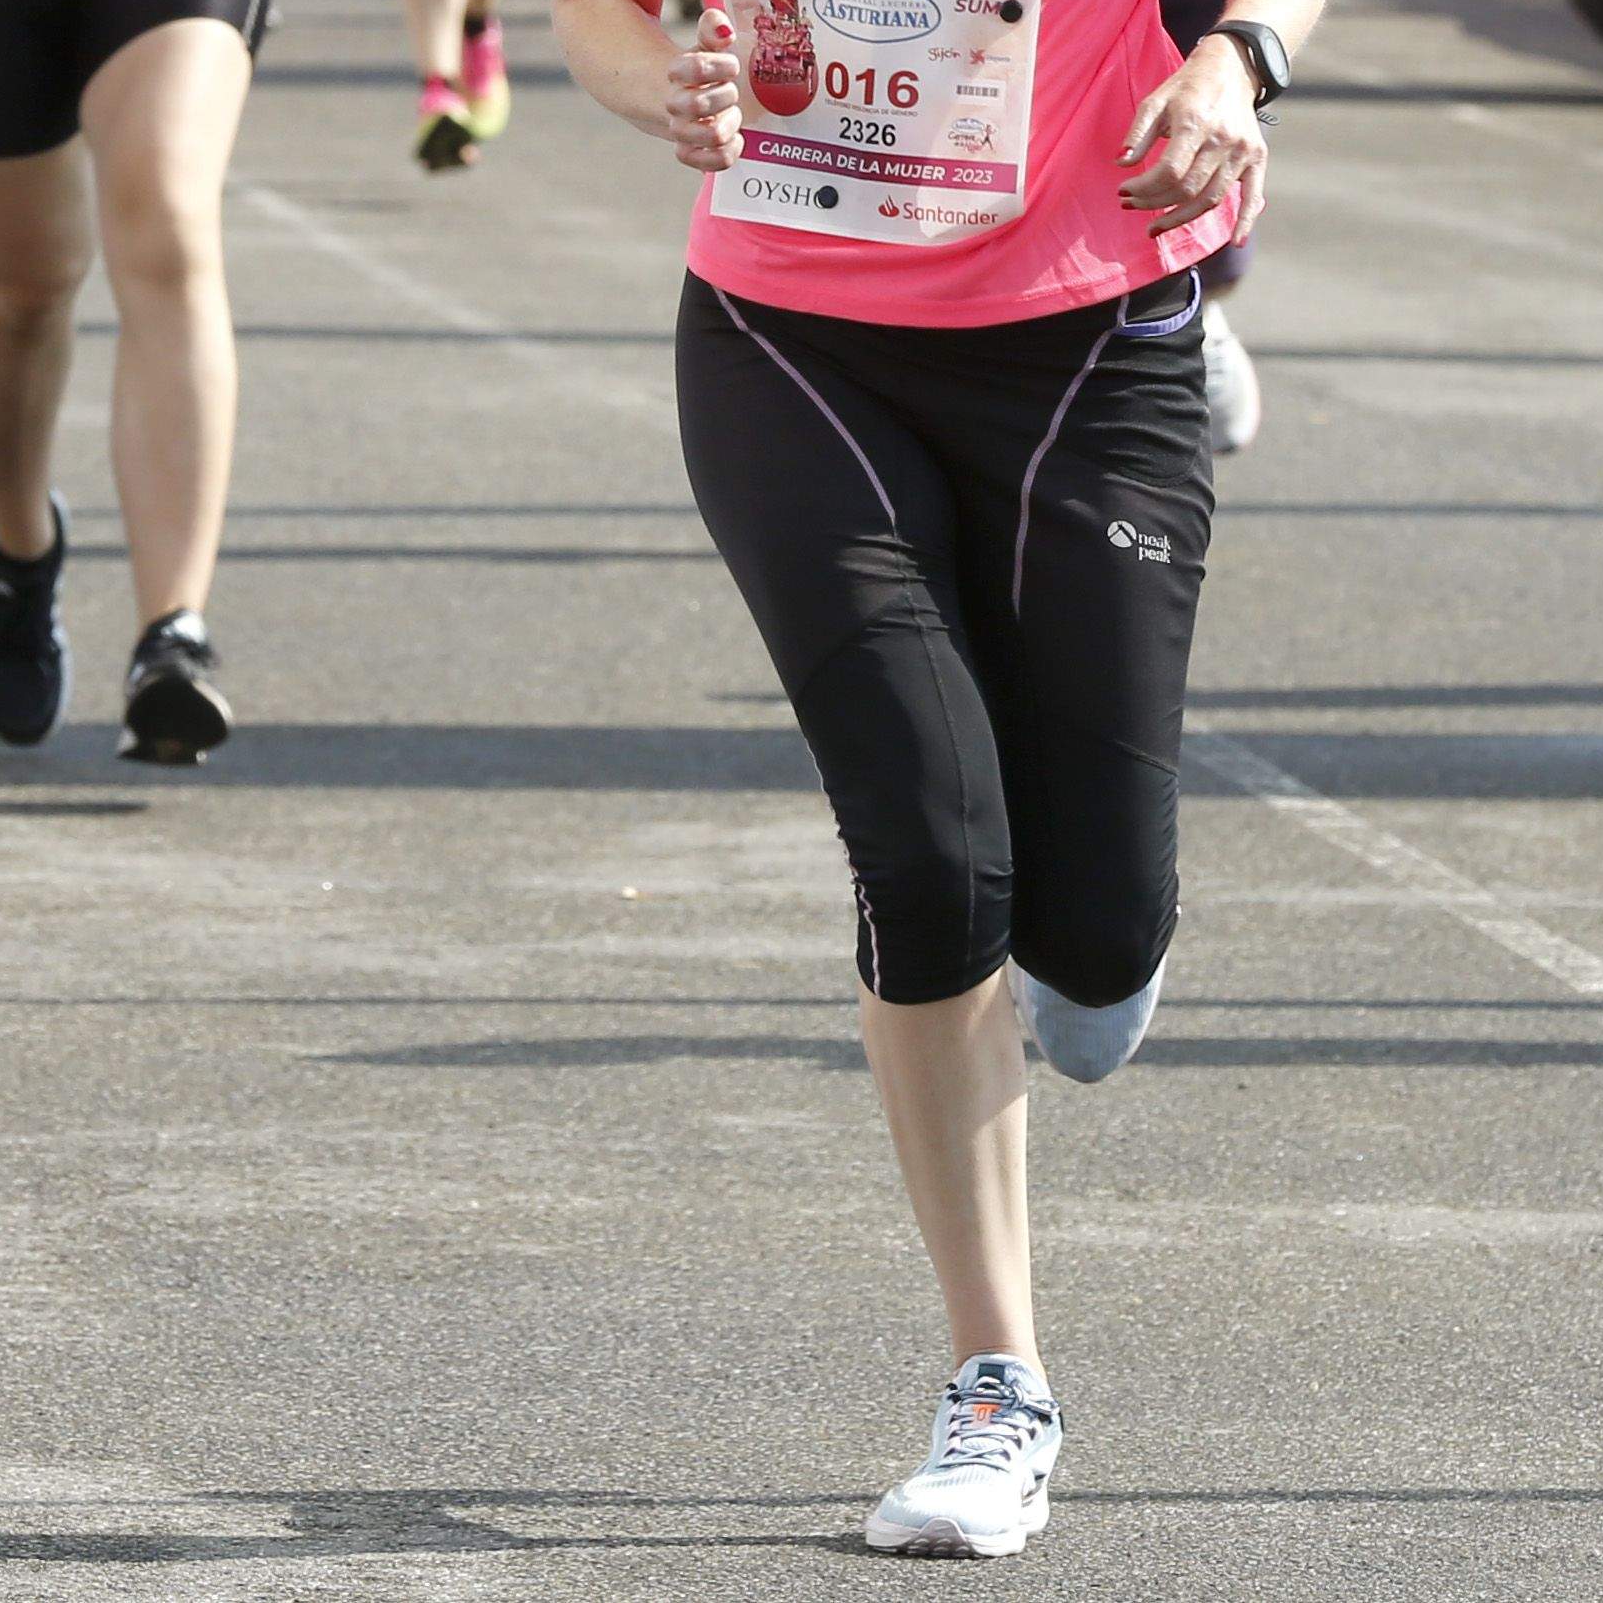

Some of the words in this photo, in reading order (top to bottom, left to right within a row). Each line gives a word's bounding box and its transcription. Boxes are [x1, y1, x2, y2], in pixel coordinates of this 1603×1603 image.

[825, 61, 919, 109] 016
[839, 116, 896, 147] 2326
[758, 140, 832, 166] CARRERA
[835, 155, 857, 171] DE
[858, 158, 880, 175] LA
[884, 162, 946, 181] MUJER
[952, 166, 994, 185] 2023
[903, 202, 999, 226] Santander
[1138, 546, 1171, 564] peak
